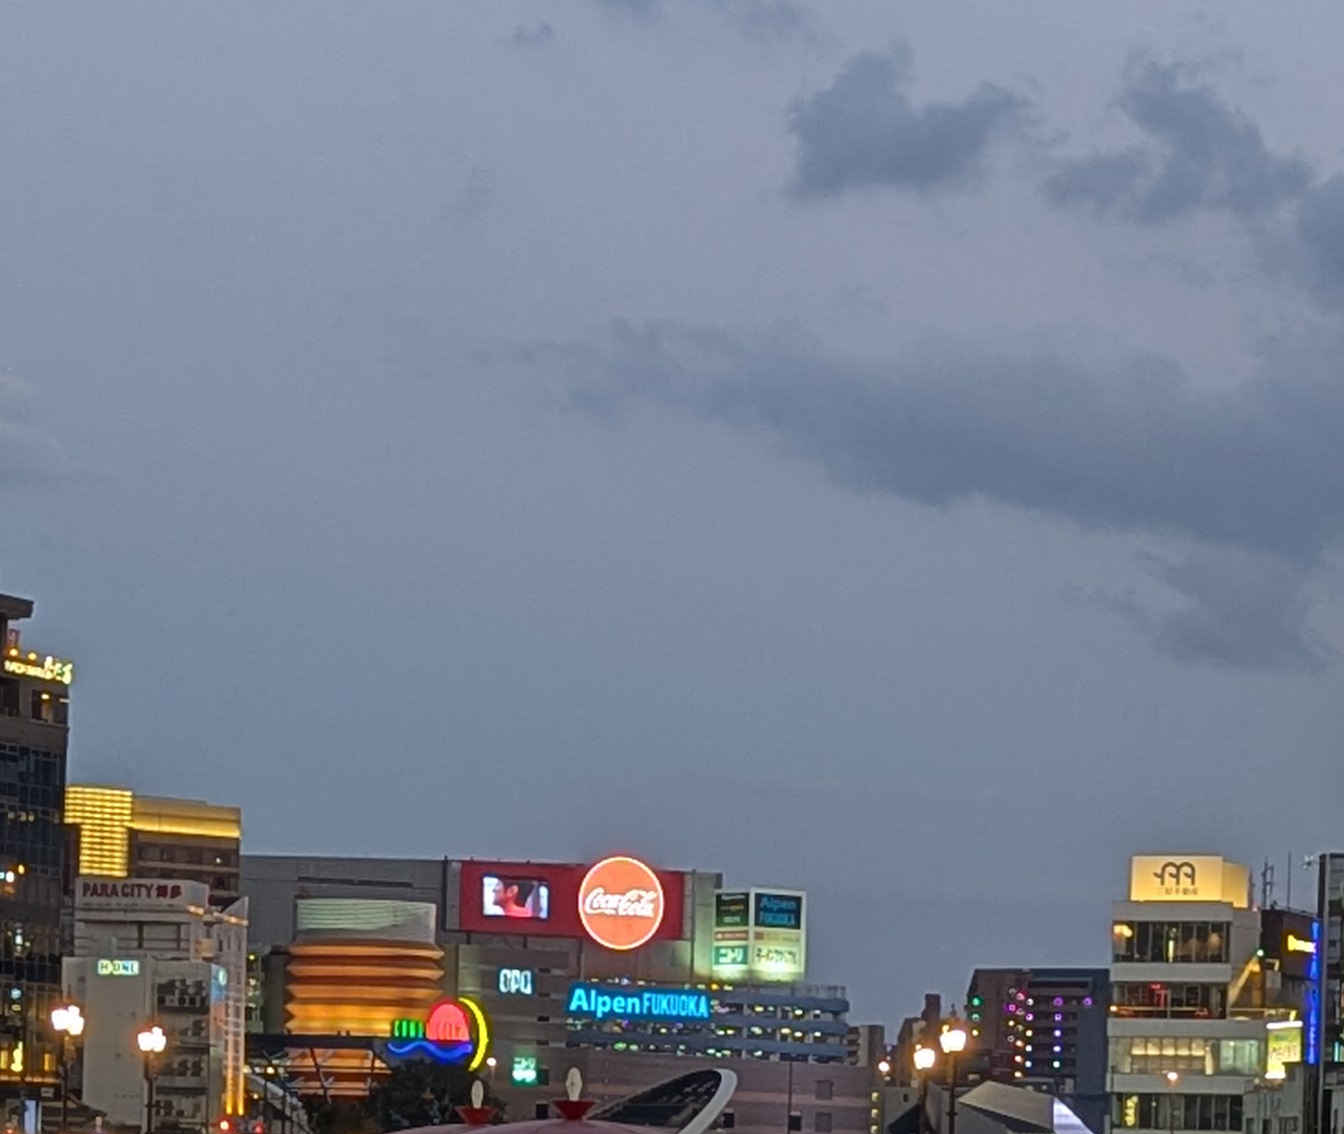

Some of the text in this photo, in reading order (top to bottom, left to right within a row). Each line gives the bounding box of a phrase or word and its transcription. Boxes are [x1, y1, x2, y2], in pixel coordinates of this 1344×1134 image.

[121, 883, 154, 899] CITY
[719, 947, 744, 964] ニトリ
[569, 988, 709, 1018] Alpen FUKUOKA
